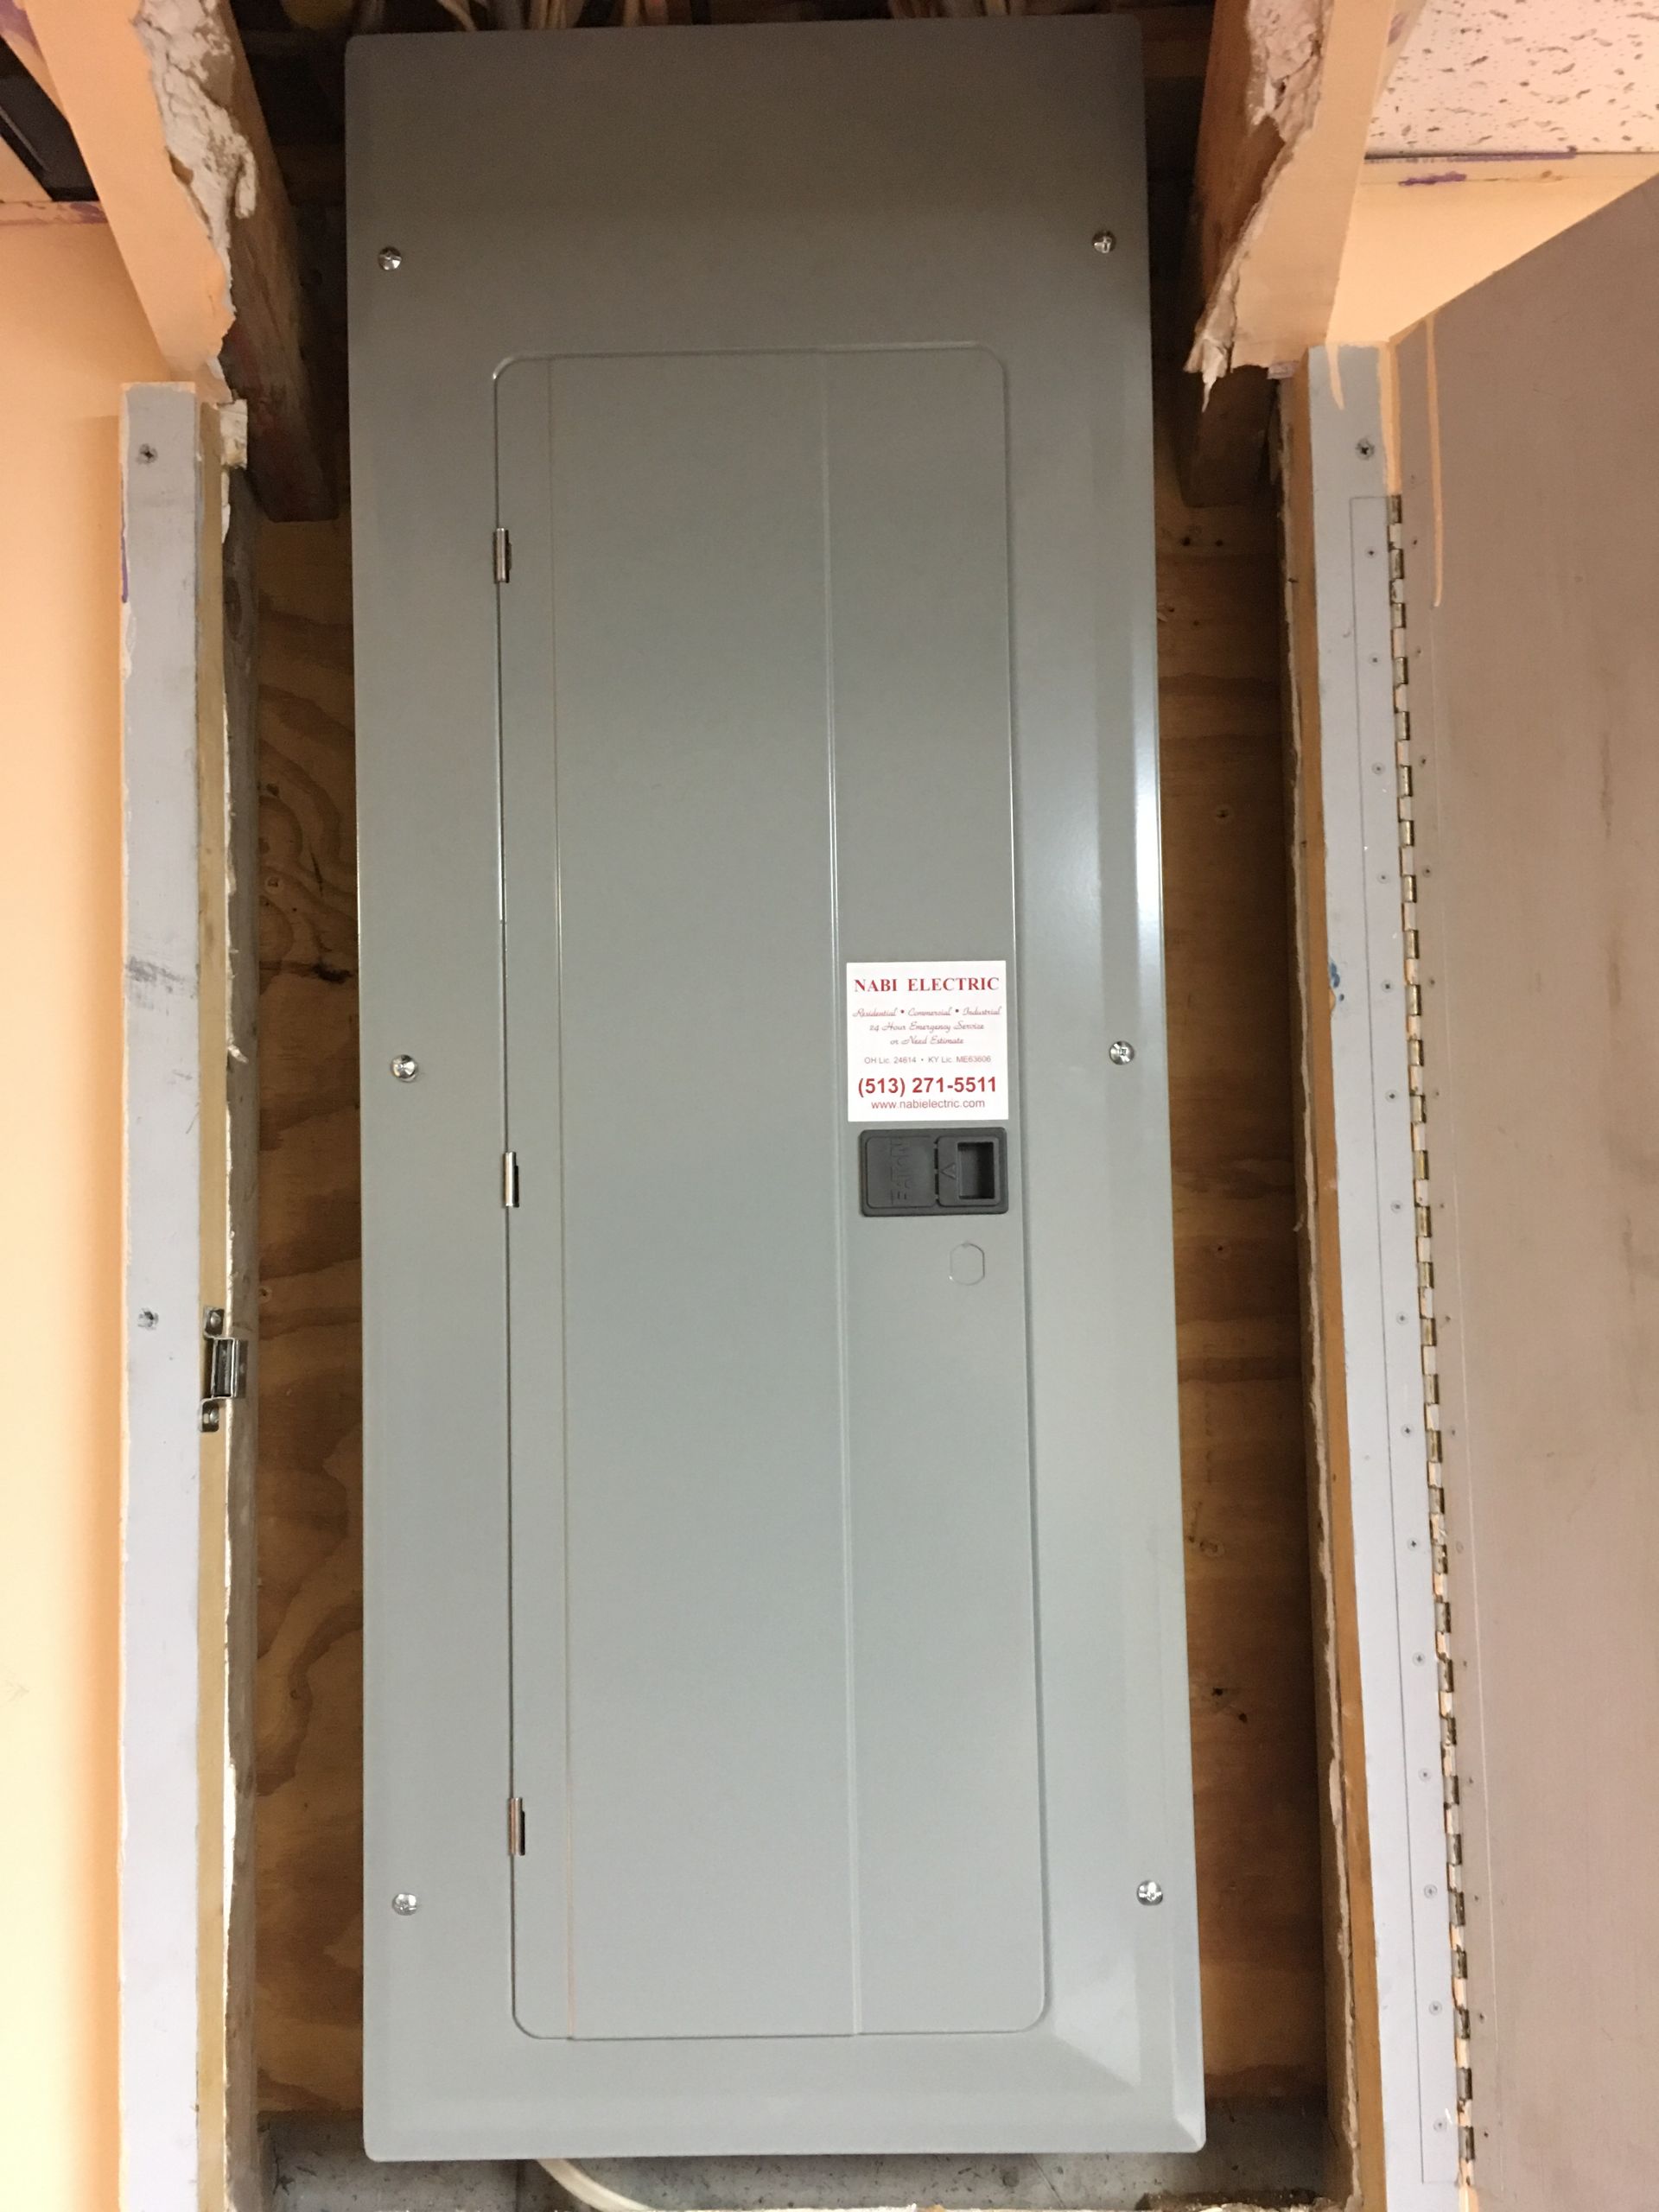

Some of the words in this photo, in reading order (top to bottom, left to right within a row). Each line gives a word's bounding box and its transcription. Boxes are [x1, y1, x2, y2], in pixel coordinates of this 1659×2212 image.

[854, 978, 898, 992] NABI
[907, 976, 1000, 992] ELECTRIC
[853, 1007, 899, 1017] Residential
[907, 1006, 952, 1016] Commercial
[963, 1005, 1002, 1015] Industrial
[881, 1022, 906, 1031] Hour
[909, 1020, 951, 1033] Emergency
[953, 1020, 984, 1030] Service
[930, 1035, 964, 1045] Estimate
[858, 1077, 906, 1097] (513)
[912, 1077, 996, 1093] 271-5511
[871, 1098, 986, 1109] www.nabielectric.com
